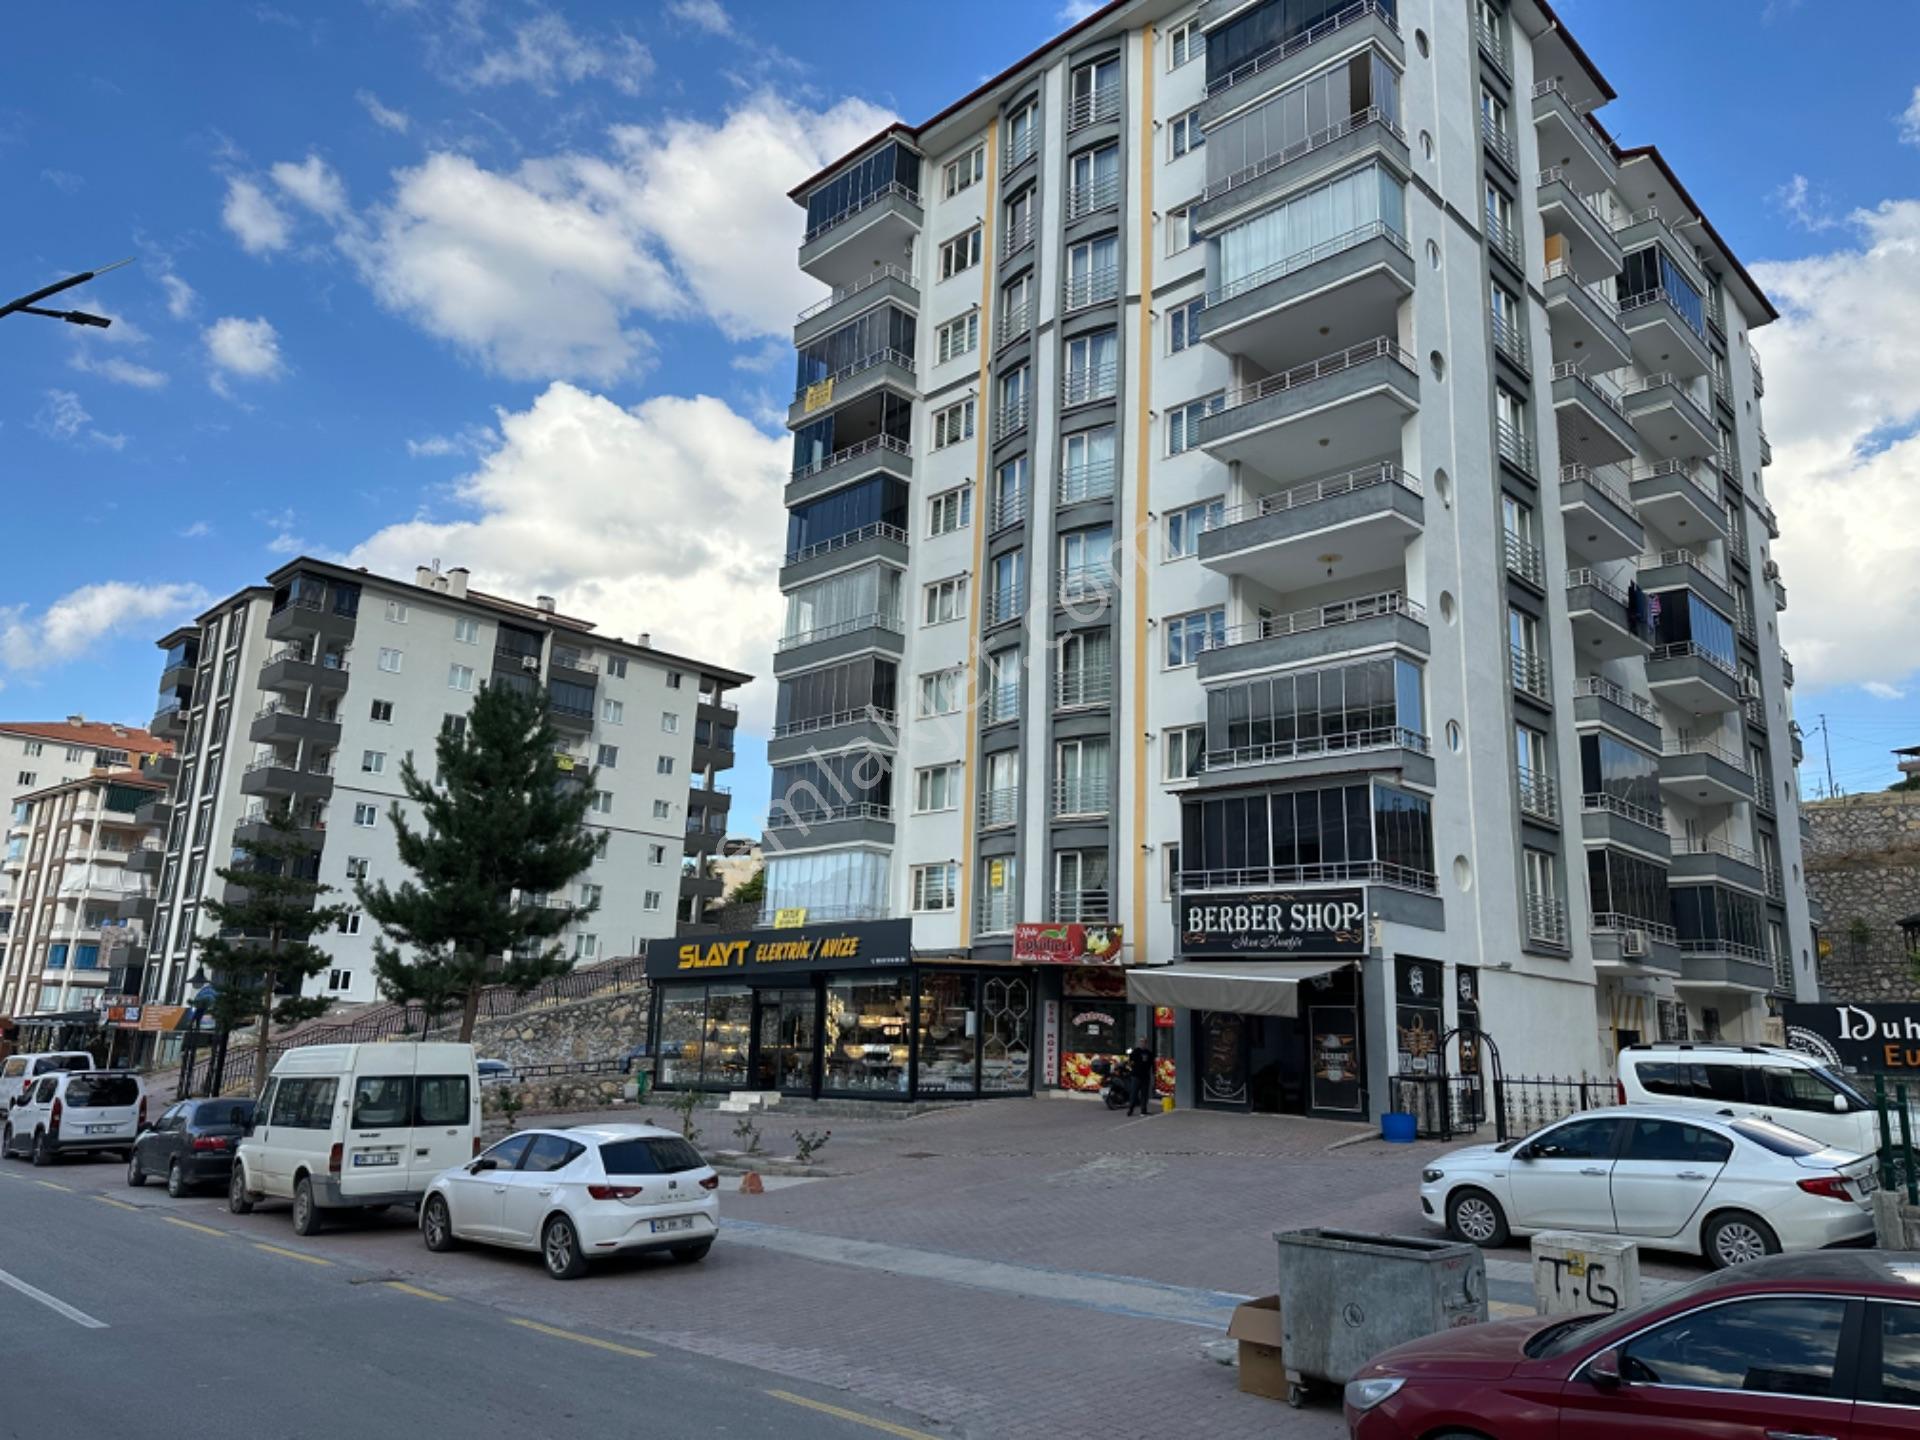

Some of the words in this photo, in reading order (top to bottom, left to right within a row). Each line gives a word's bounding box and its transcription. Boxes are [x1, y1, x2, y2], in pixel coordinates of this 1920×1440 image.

[1188, 904, 1283, 934] BERBER
[1289, 901, 1360, 932] SHOP
[678, 939, 750, 970] SLAYT
[755, 935, 809, 964] ELEKTRİK
[820, 931, 860, 958] AVİZE
